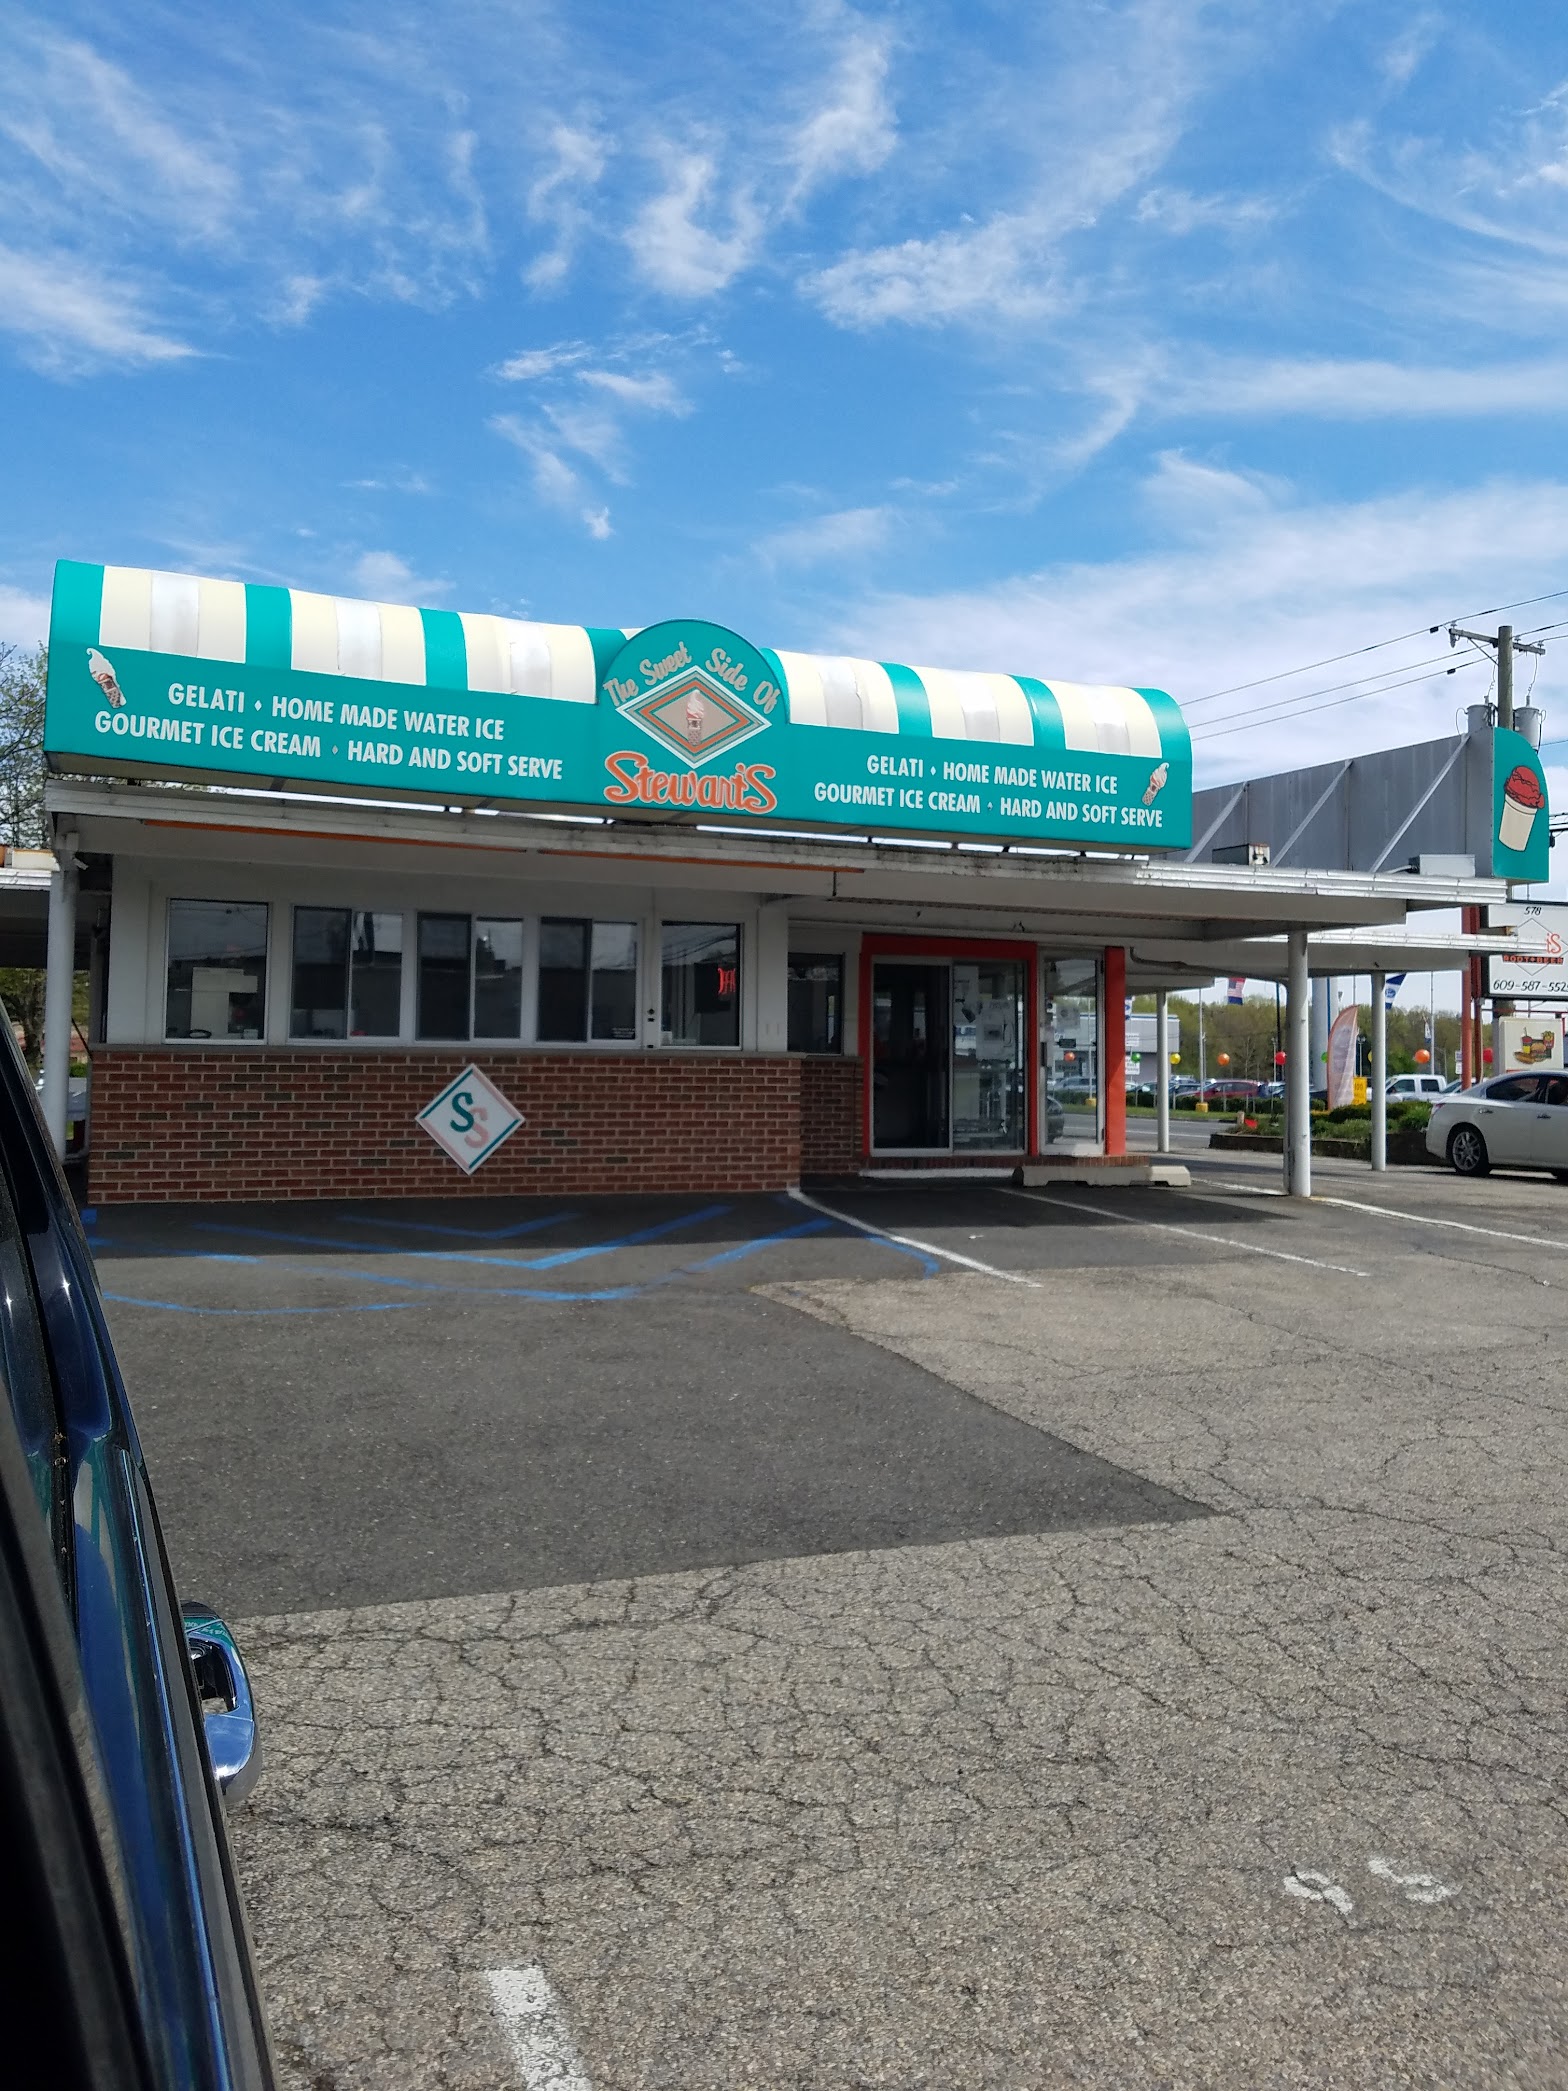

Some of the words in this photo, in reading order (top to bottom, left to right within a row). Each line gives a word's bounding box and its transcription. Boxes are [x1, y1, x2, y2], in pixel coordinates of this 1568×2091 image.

[603, 678, 639, 707] The
[639, 641, 692, 686] Sweet
[705, 647, 748, 691] Side
[752, 681, 781, 713] Of
[168, 682, 245, 714] GELATI
[271, 695, 335, 724] HOME
[340, 703, 399, 731] MADE
[403, 710, 470, 738] WATER
[475, 717, 505, 741] ICE
[94, 710, 205, 746] GOURMET
[211, 724, 244, 750] ICE
[250, 729, 322, 758] CREAM
[347, 739, 404, 766] HARD
[408, 746, 451, 770] AND
[456, 750, 503, 775] SOFT
[507, 754, 564, 780] SERVE
[866, 754, 924, 779] GELATI
[943, 761, 990, 784] HOME
[993, 765, 1037, 788] MADE
[1041, 769, 1092, 793] WATER
[1095, 774, 1118, 795] ICE
[814, 781, 896, 807] GOURMET
[899, 788, 924, 809] ICE
[928, 791, 981, 814] CREAM
[1000, 796, 1042, 818] HARD
[1045, 800, 1078, 821] AND
[1082, 804, 1118, 824] SOFT
[1120, 806, 1163, 828] SERVE
[1523, 906, 1542, 916] 578
[1493, 980, 1568, 993] 609-587-552
